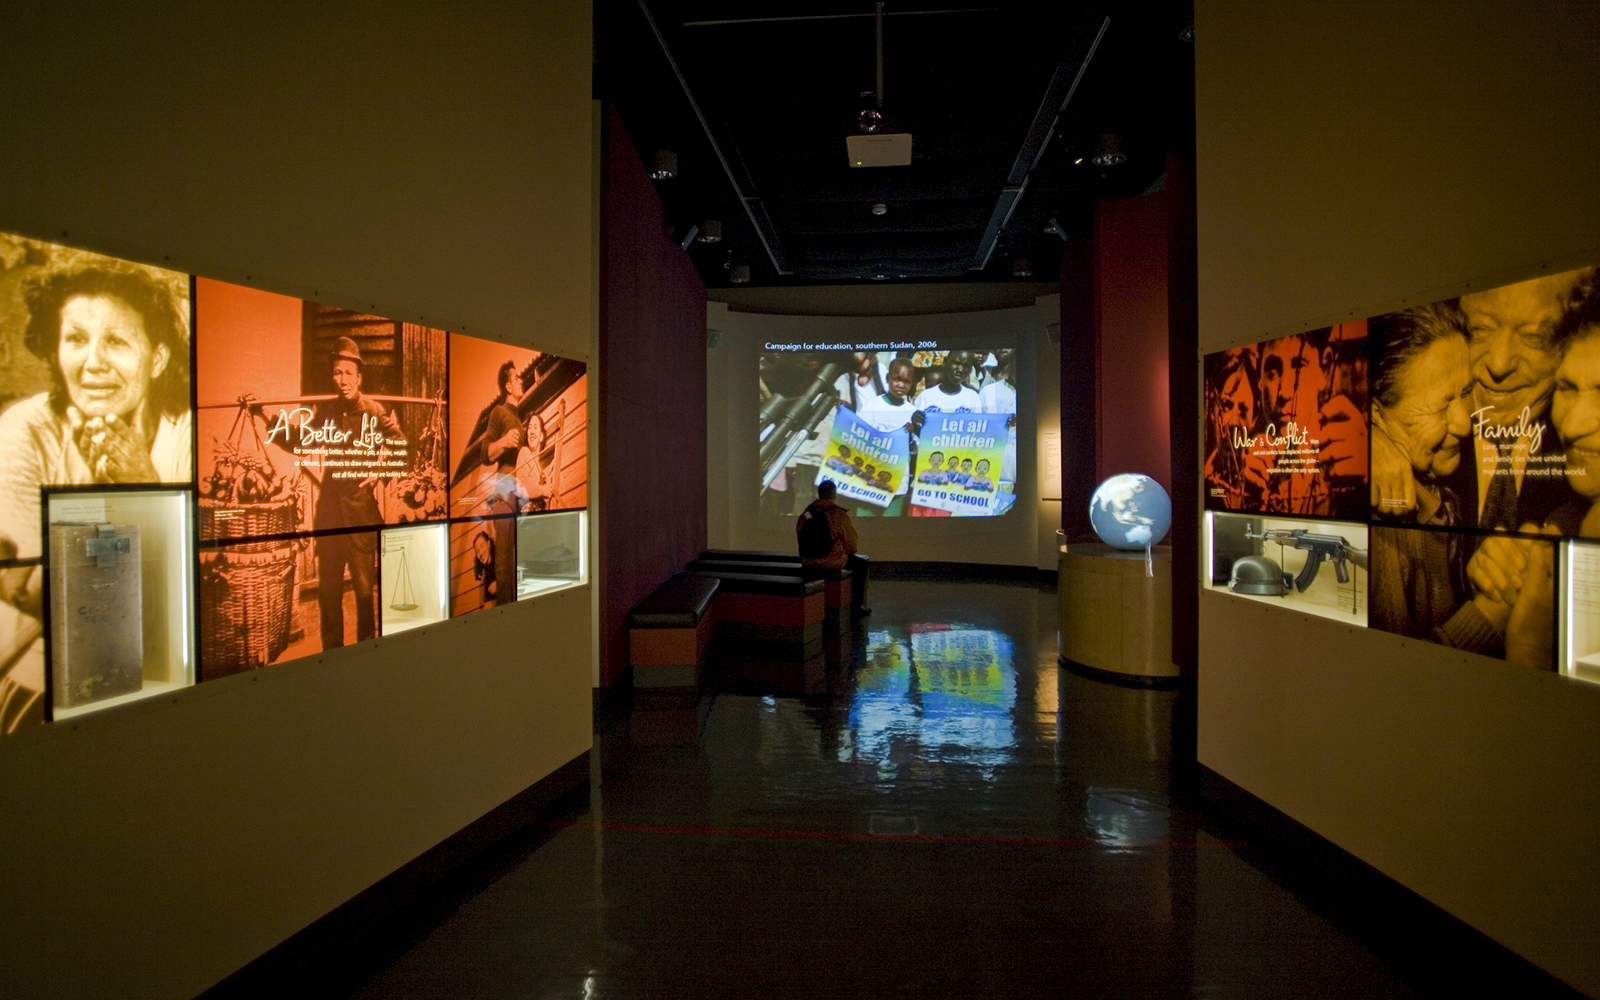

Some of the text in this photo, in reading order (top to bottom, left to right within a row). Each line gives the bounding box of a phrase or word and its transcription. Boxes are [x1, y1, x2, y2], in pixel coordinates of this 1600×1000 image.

[765, 342, 801, 351] Campaign
[815, 342, 853, 350] education,
[890, 341, 915, 349] Sudan,
[264, 409, 290, 444] A
[289, 408, 352, 446] Better
[353, 412, 383, 450] Life
[942, 418, 988, 433] Let all
[1470, 405, 1547, 454] Family
[850, 421, 893, 450] Let all
[932, 434, 995, 448] children
[1234, 427, 1257, 448] War
[1260, 438, 1264, 447] &
[1266, 422, 1308, 449] Conflict
[302, 448, 328, 456] something
[329, 448, 344, 456] better,
[841, 431, 899, 465] children
[1483, 443, 1527, 452] Love, marriage
[1495, 455, 1513, 464] family
[1544, 454, 1567, 462] united
[369, 471, 378, 480] they
[386, 471, 401, 479] looking
[1483, 469, 1508, 477] migrants
[1526, 468, 1550, 476] around
[1551, 468, 1563, 476] the
[1564, 468, 1587, 476] world.
[837, 480, 848, 491] TO
[850, 486, 887, 502] SCHOOL
[918, 489, 931, 497] GO
[934, 491, 947, 499] TO
[949, 493, 989, 508] SCHOOL
